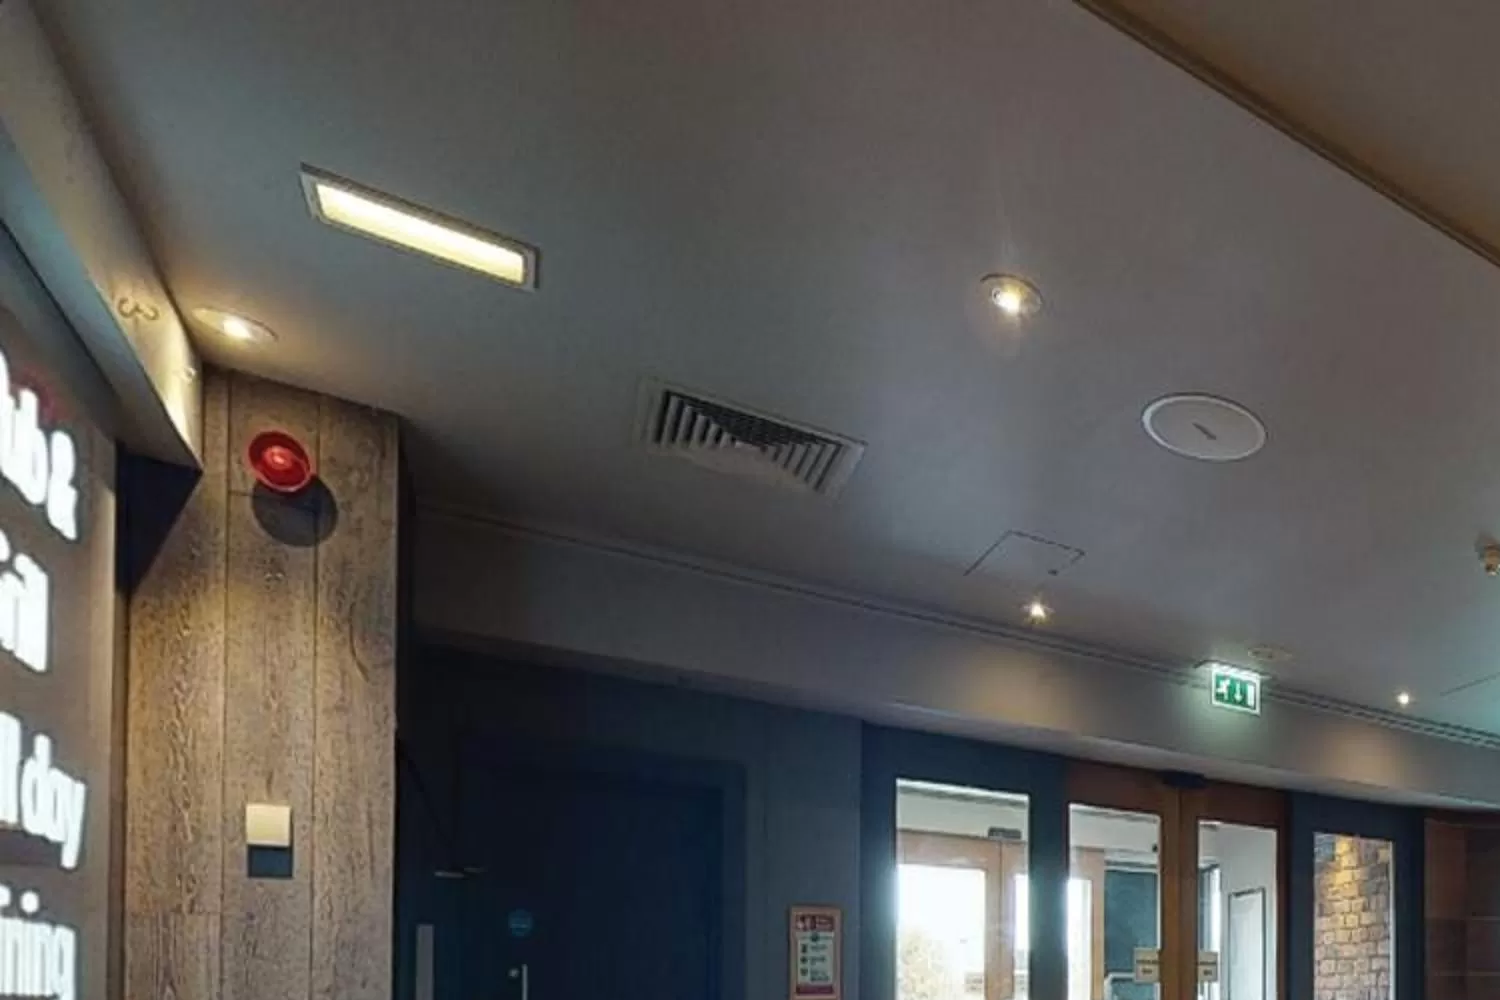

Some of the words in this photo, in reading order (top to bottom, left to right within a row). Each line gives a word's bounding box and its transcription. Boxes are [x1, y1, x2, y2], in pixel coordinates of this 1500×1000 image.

[0, 355, 48, 505] ub
[48, 430, 77, 540] &
[21, 734, 86, 869] day
